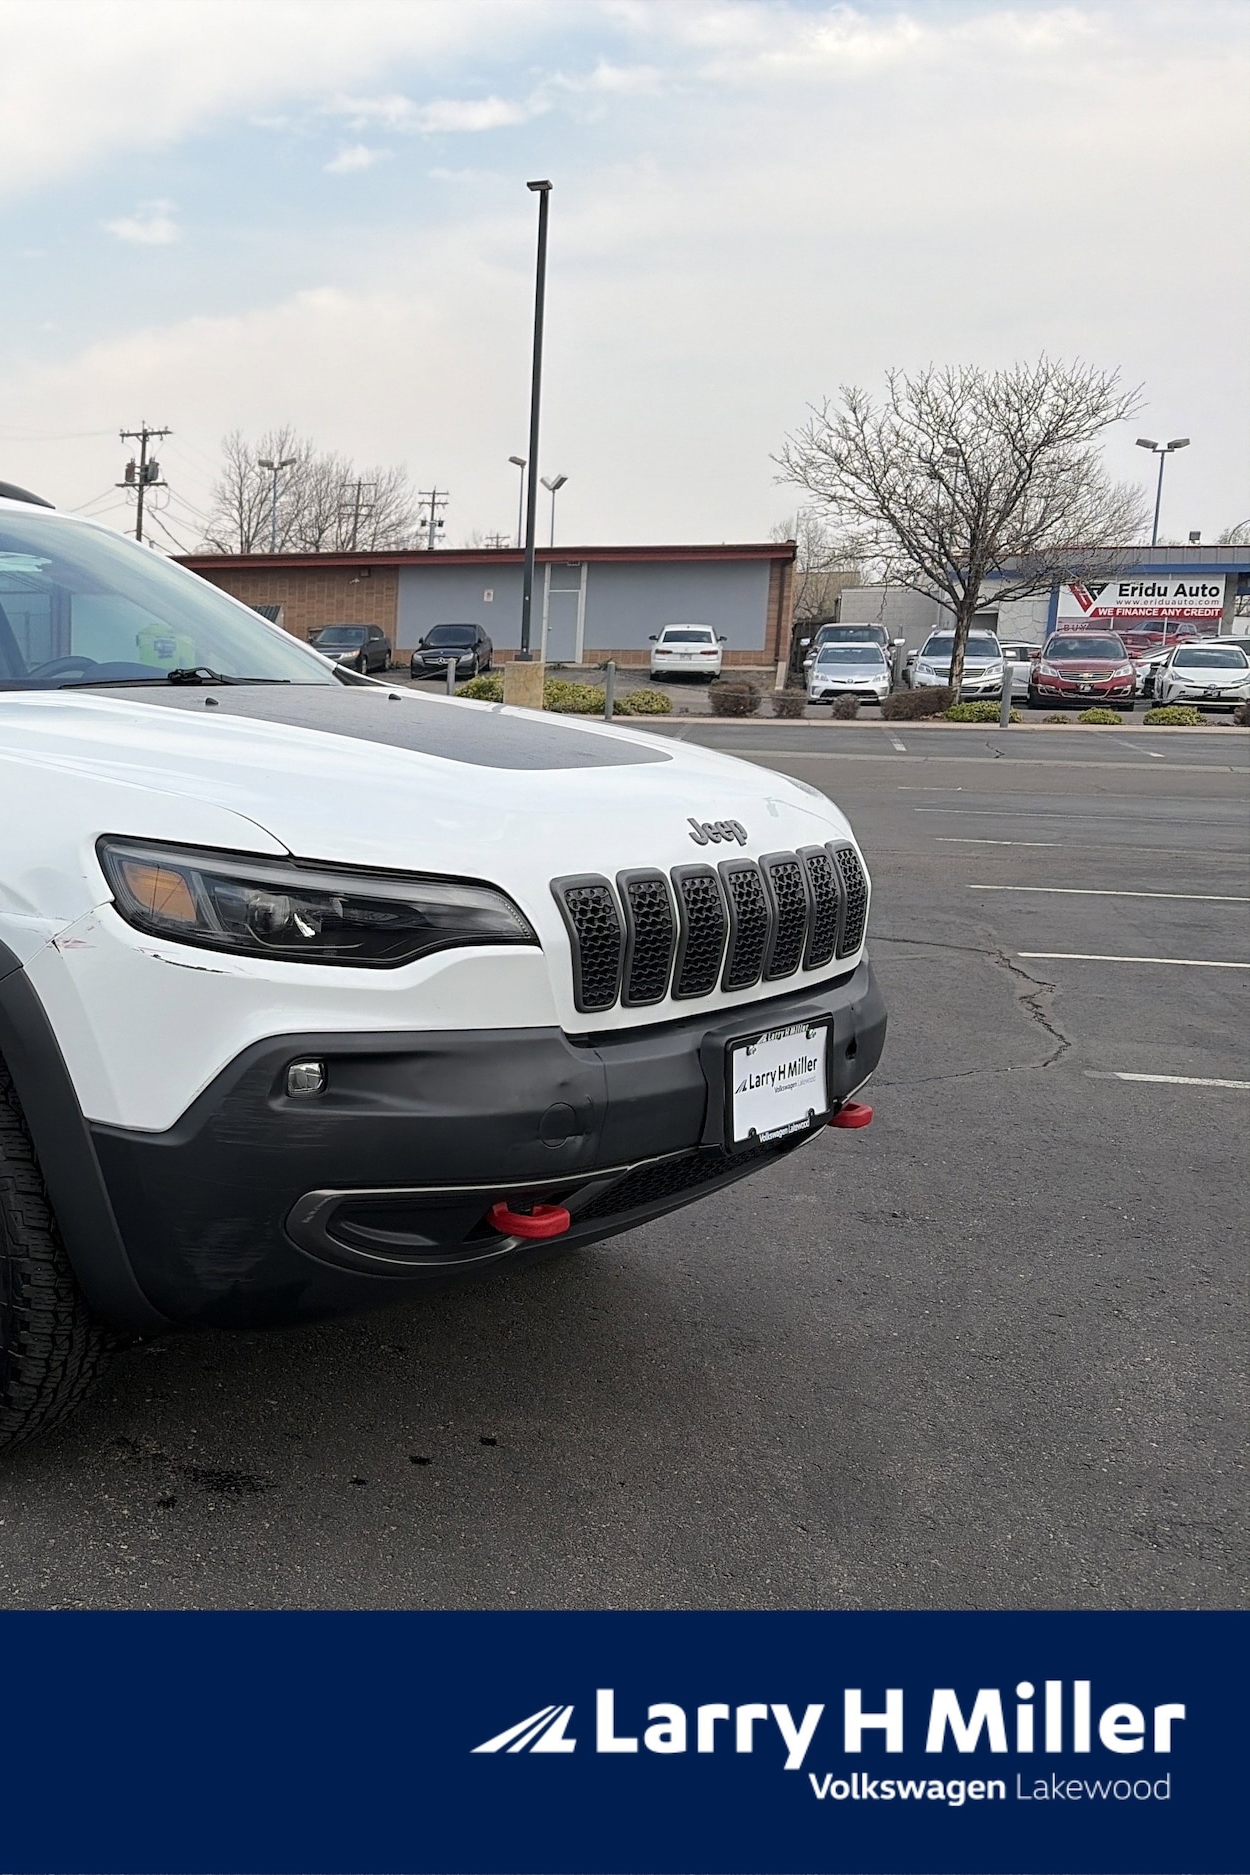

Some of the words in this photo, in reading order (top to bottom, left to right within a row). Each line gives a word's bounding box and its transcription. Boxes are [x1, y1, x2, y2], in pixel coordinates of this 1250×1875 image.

[1118, 582, 1168, 598] Eridu
[1173, 582, 1220, 598] Auto
[1098, 608, 1114, 616] WE
[1116, 608, 1159, 616] FINANCE
[1160, 608, 1183, 616] ANY
[1184, 608, 1220, 616] CREDIT
[1116, 598, 1220, 606] www.eriduauto.com
[687, 818, 748, 847] Jeep
[749, 1069, 777, 1090] Larry
[778, 1063, 786, 1081] H
[787, 1055, 818, 1079] Miller
[759, 1125, 789, 1143] Volkswagen
[788, 1118, 811, 1134] Lakewood
